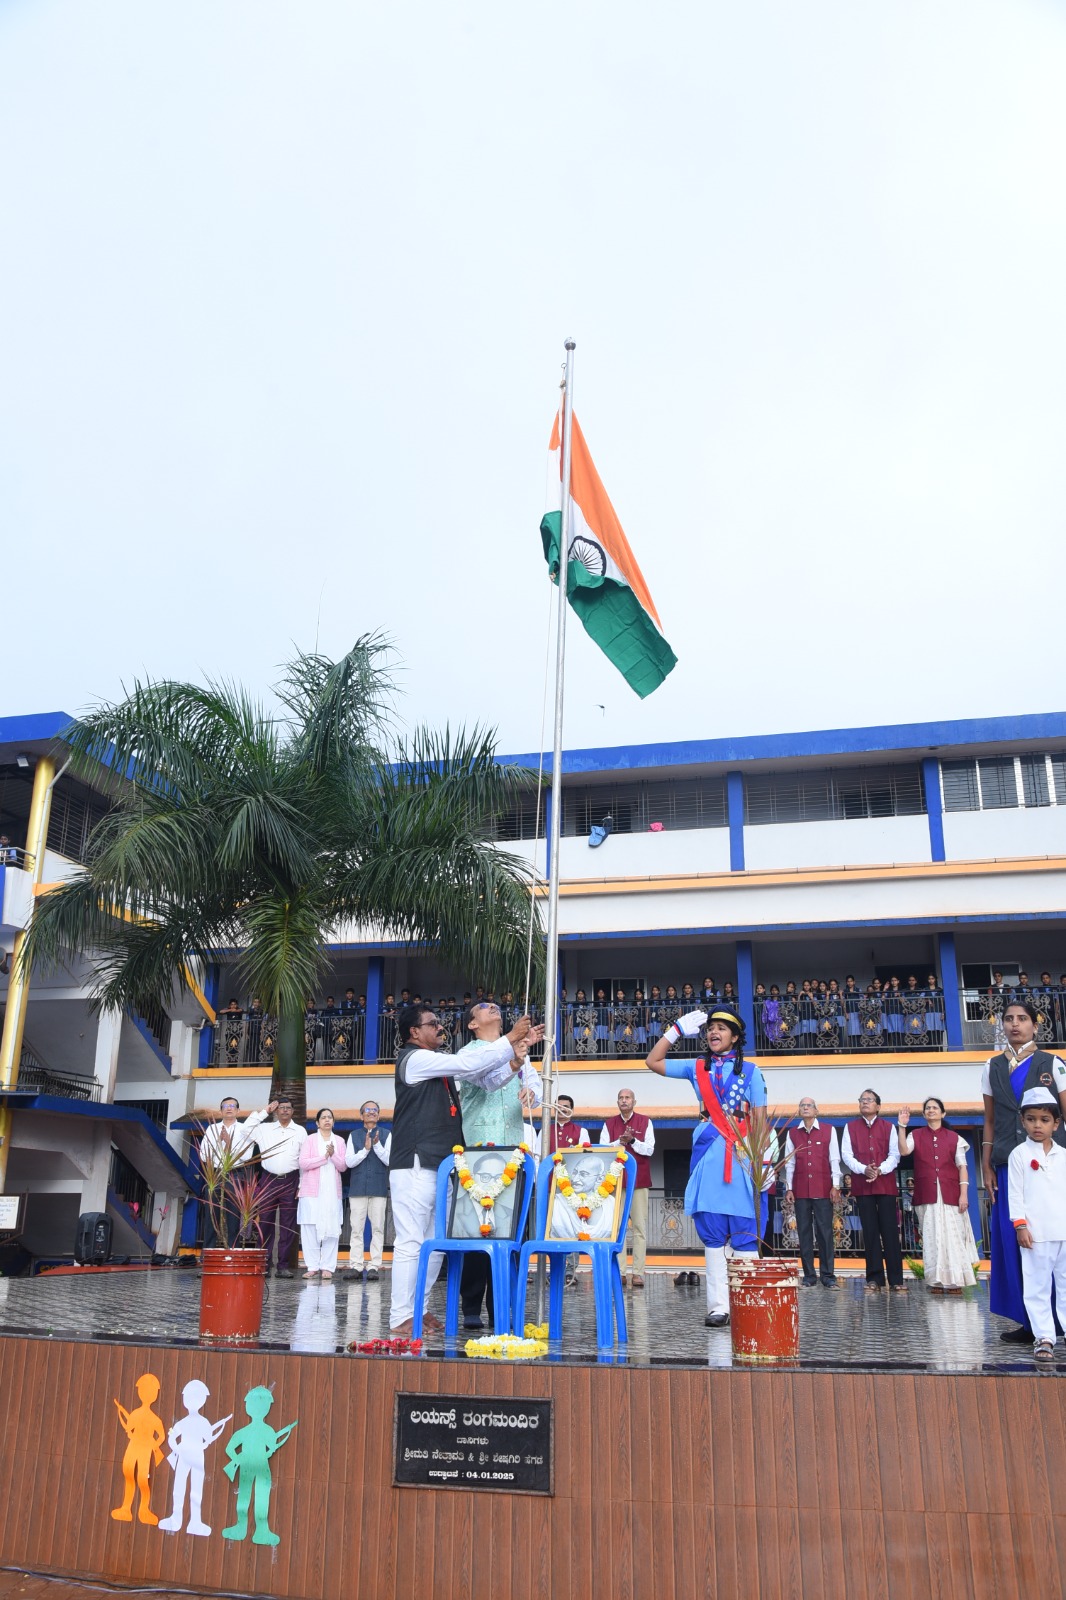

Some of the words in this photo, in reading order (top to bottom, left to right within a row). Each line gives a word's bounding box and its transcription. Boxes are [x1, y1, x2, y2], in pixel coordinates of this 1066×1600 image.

[463, 1410, 540, 1429] ರಂಗಮಂದಿರ
[456, 1436, 489, 1445] ದಾನಿಗಳು
[404, 1447, 429, 1461] ಶ್ರೀಮತಿ
[468, 1452, 475, 1462] &
[478, 1451, 489, 1465] ಶ್ರೀ
[466, 1471, 515, 1480] 04.01.2025
